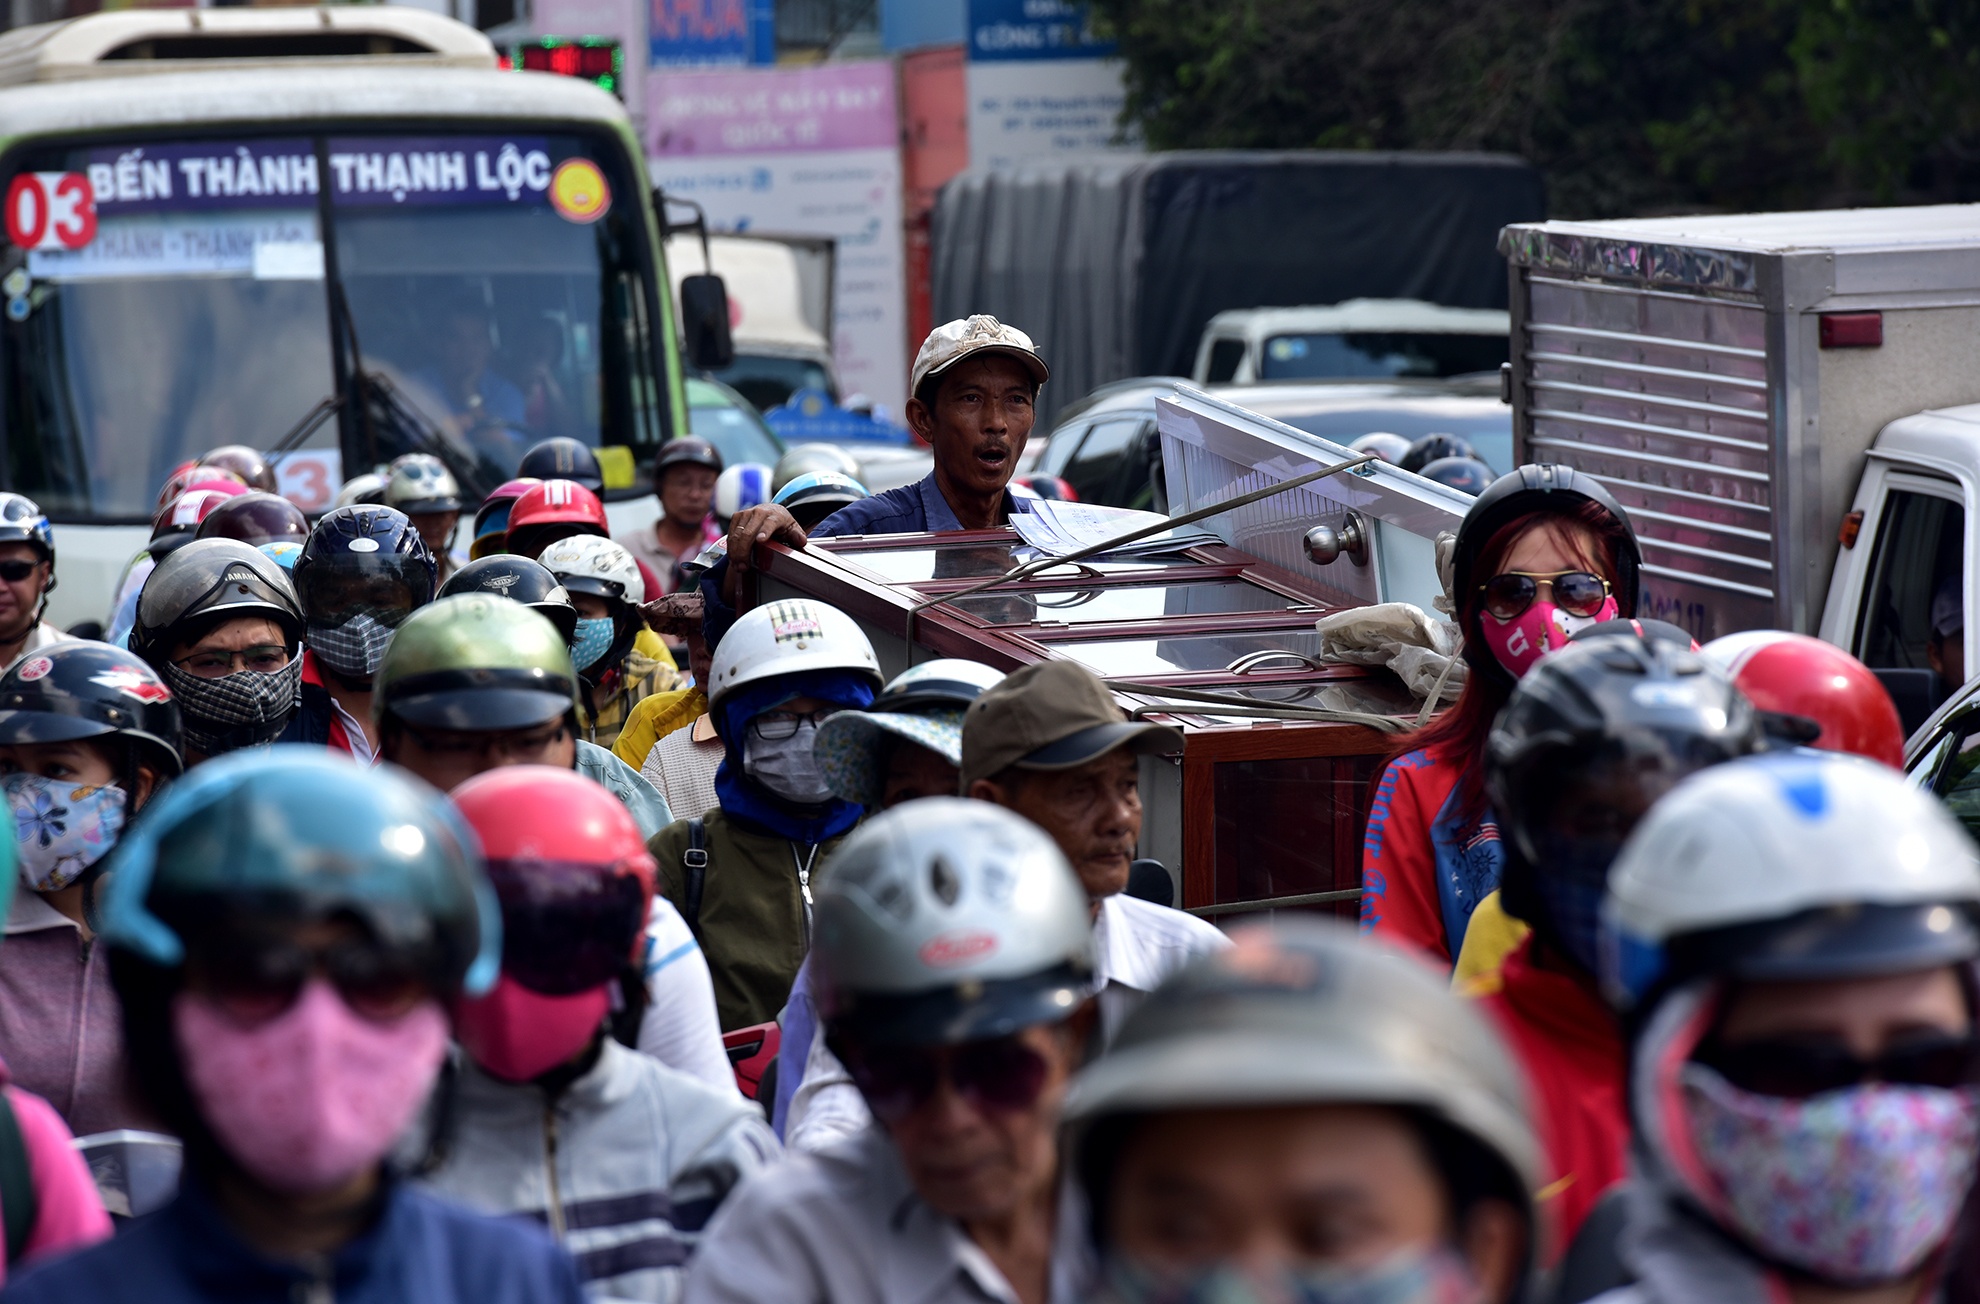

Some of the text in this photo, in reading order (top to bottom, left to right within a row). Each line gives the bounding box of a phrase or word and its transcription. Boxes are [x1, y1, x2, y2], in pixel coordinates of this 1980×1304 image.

[88, 142, 551, 203] BẾN THÀNH THẠNH LỘC
[5, 171, 97, 249] 03
